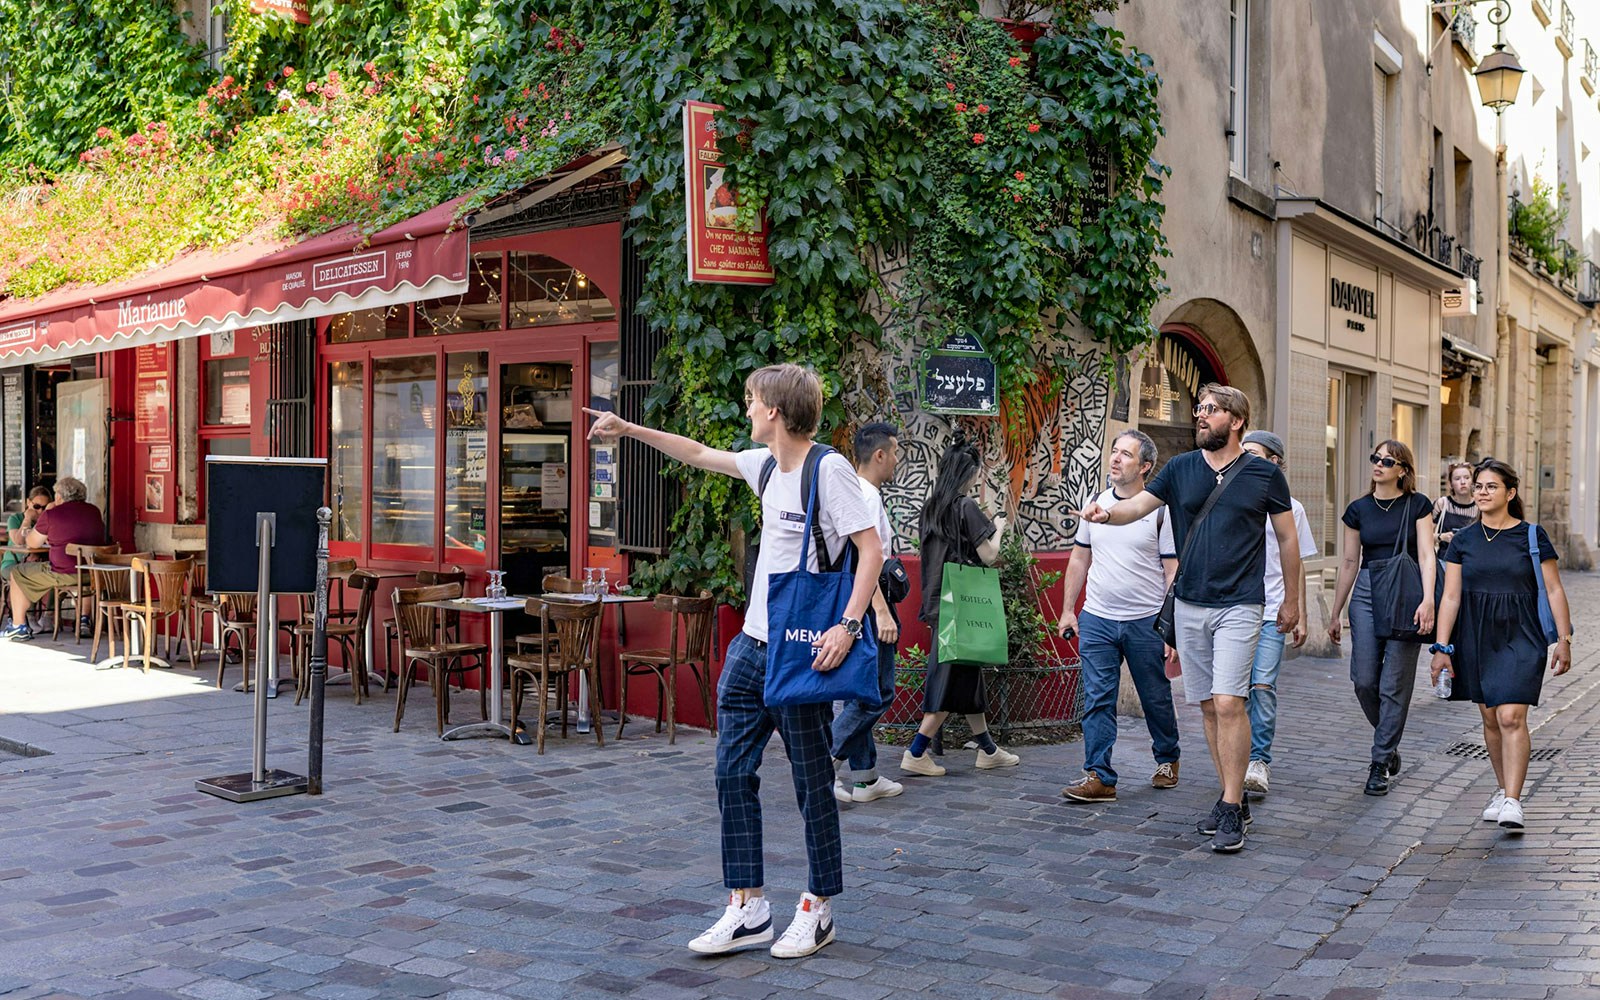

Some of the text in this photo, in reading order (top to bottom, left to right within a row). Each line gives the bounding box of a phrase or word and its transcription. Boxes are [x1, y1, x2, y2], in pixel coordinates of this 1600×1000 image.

[264, 0, 310, 12] PASTRAMI
[705, 229, 714, 239] On
[395, 249, 413, 261] DEPUIS
[709, 244, 760, 257] CHEZ MARIANNE
[398, 261, 410, 270] 1976
[703, 257, 717, 267] Sans
[285, 271, 303, 281] MAISON
[319, 259, 379, 282] DELICATESSEN
[282, 283, 289, 291] DE
[1330, 277, 1378, 320] DAMYEL
[117, 294, 187, 328] Marianne
[1346, 319, 1366, 333] PARIS
[1164, 336, 1201, 398] MAISON
[935, 367, 986, 395] פלעצל
[960, 594, 993, 605] BOTTEGA
[966, 619, 994, 630] VENETA
